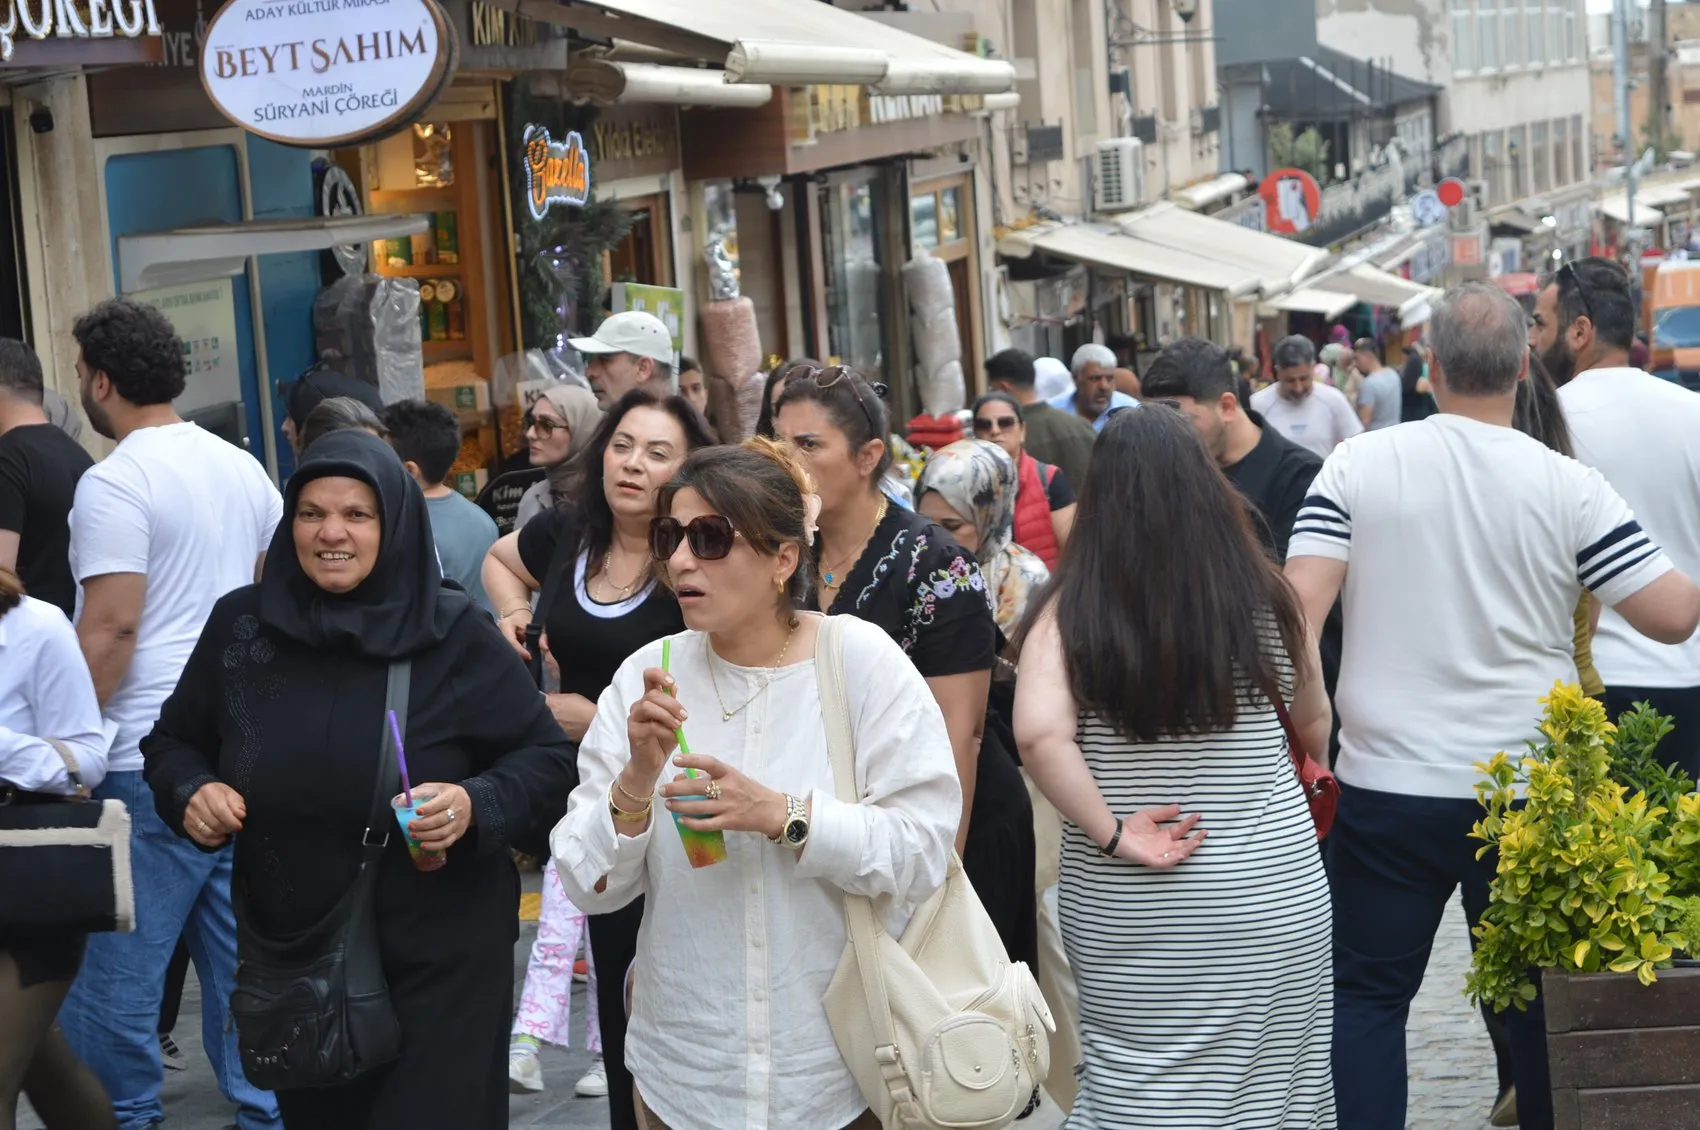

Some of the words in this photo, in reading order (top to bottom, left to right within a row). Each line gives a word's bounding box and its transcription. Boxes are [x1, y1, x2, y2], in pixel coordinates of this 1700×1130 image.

[245, 6, 284, 21] ADAY
[302, 82, 353, 98] MARDİN
[254, 97, 329, 122] SÜRYANİ
[335, 88, 398, 116] ÇÖREĞİ
